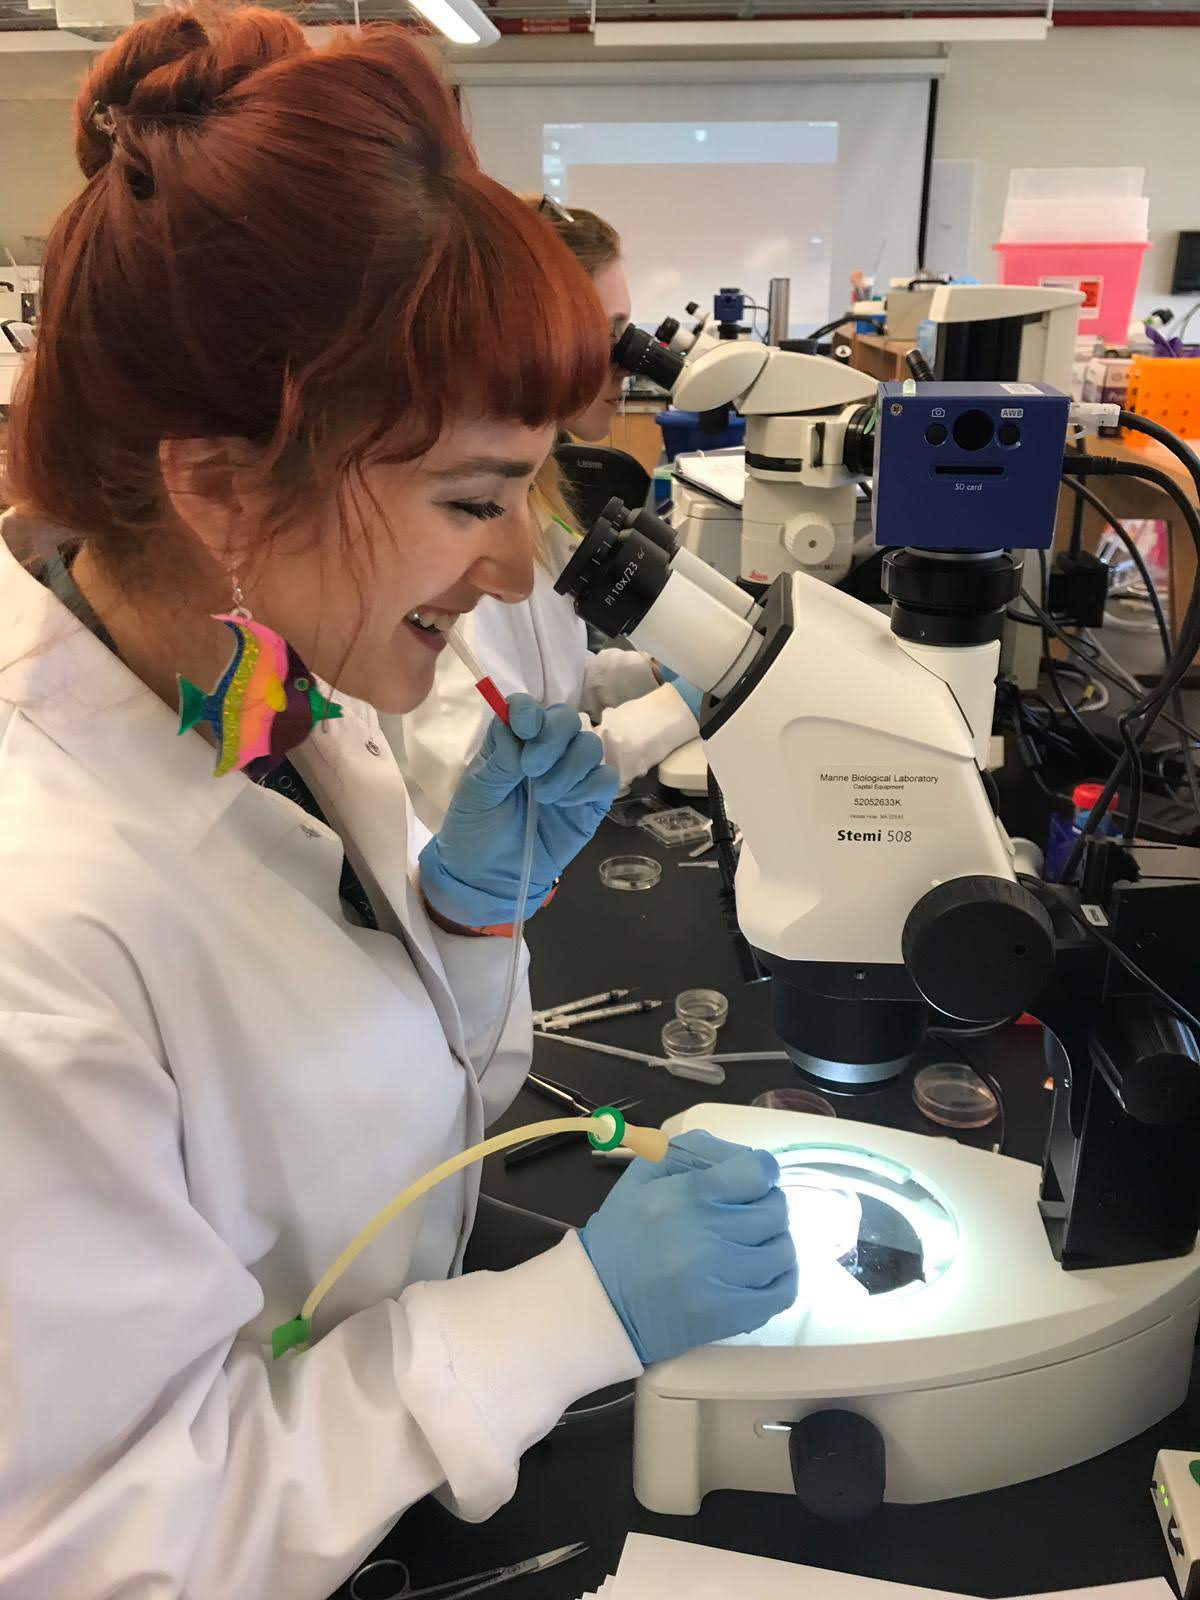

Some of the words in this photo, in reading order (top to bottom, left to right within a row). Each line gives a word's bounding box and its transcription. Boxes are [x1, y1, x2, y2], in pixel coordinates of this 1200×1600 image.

[1001, 408, 1023, 418] AWB
[955, 483, 965, 491] SD
[966, 483, 982, 491] card
[612, 561, 638, 595] 10x/23
[820, 774, 849, 782] Marine
[851, 774, 891, 784] Biological
[894, 775, 939, 784] Laboratory
[854, 798, 901, 806] 52052633K
[837, 829, 882, 842] Stemi
[887, 830, 912, 843] 508
